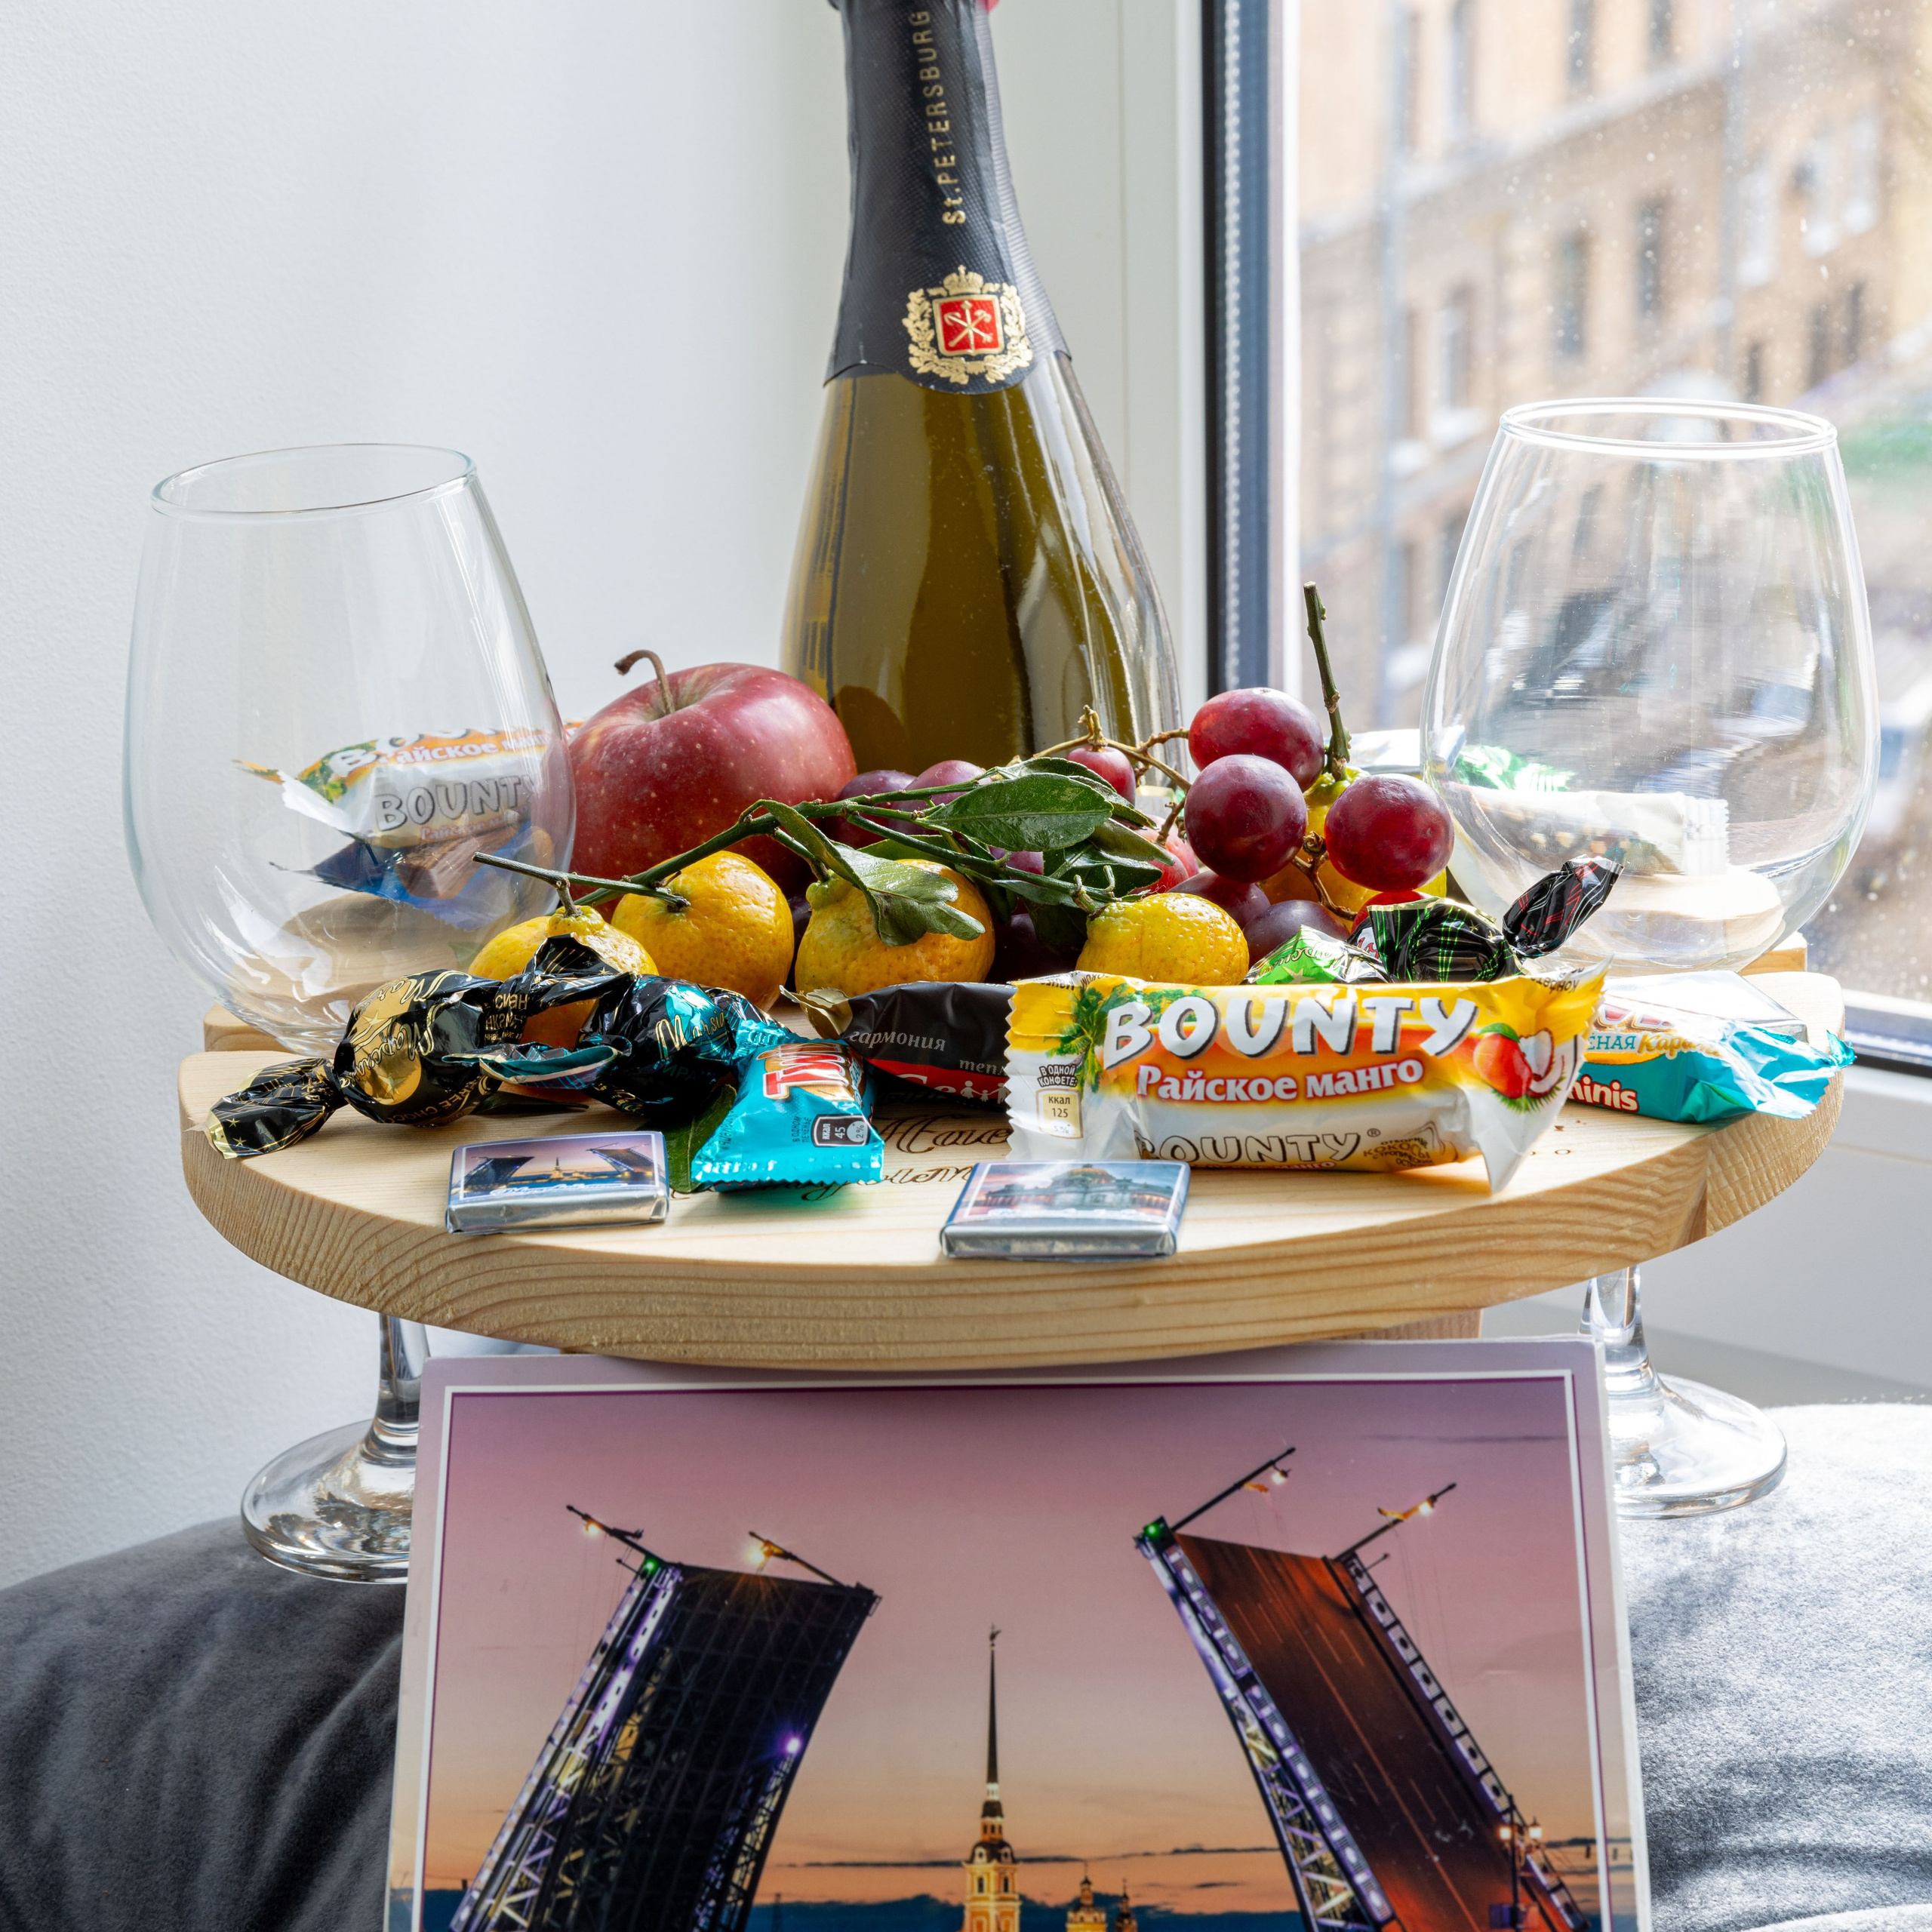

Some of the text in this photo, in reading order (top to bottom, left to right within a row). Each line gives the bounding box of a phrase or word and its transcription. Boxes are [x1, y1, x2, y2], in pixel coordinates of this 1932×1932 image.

[1106, 995, 1479, 1072] BOUNTY
[849, 1031, 946, 1052] гармония
[1048, 1065, 1076, 1076] ОДНОЙ
[1137, 1059, 1424, 1102] Райское манго
[1048, 1096, 1071, 1105] ккал
[1051, 1107, 1069, 1118] 125
[834, 1126, 846, 1139] 45
